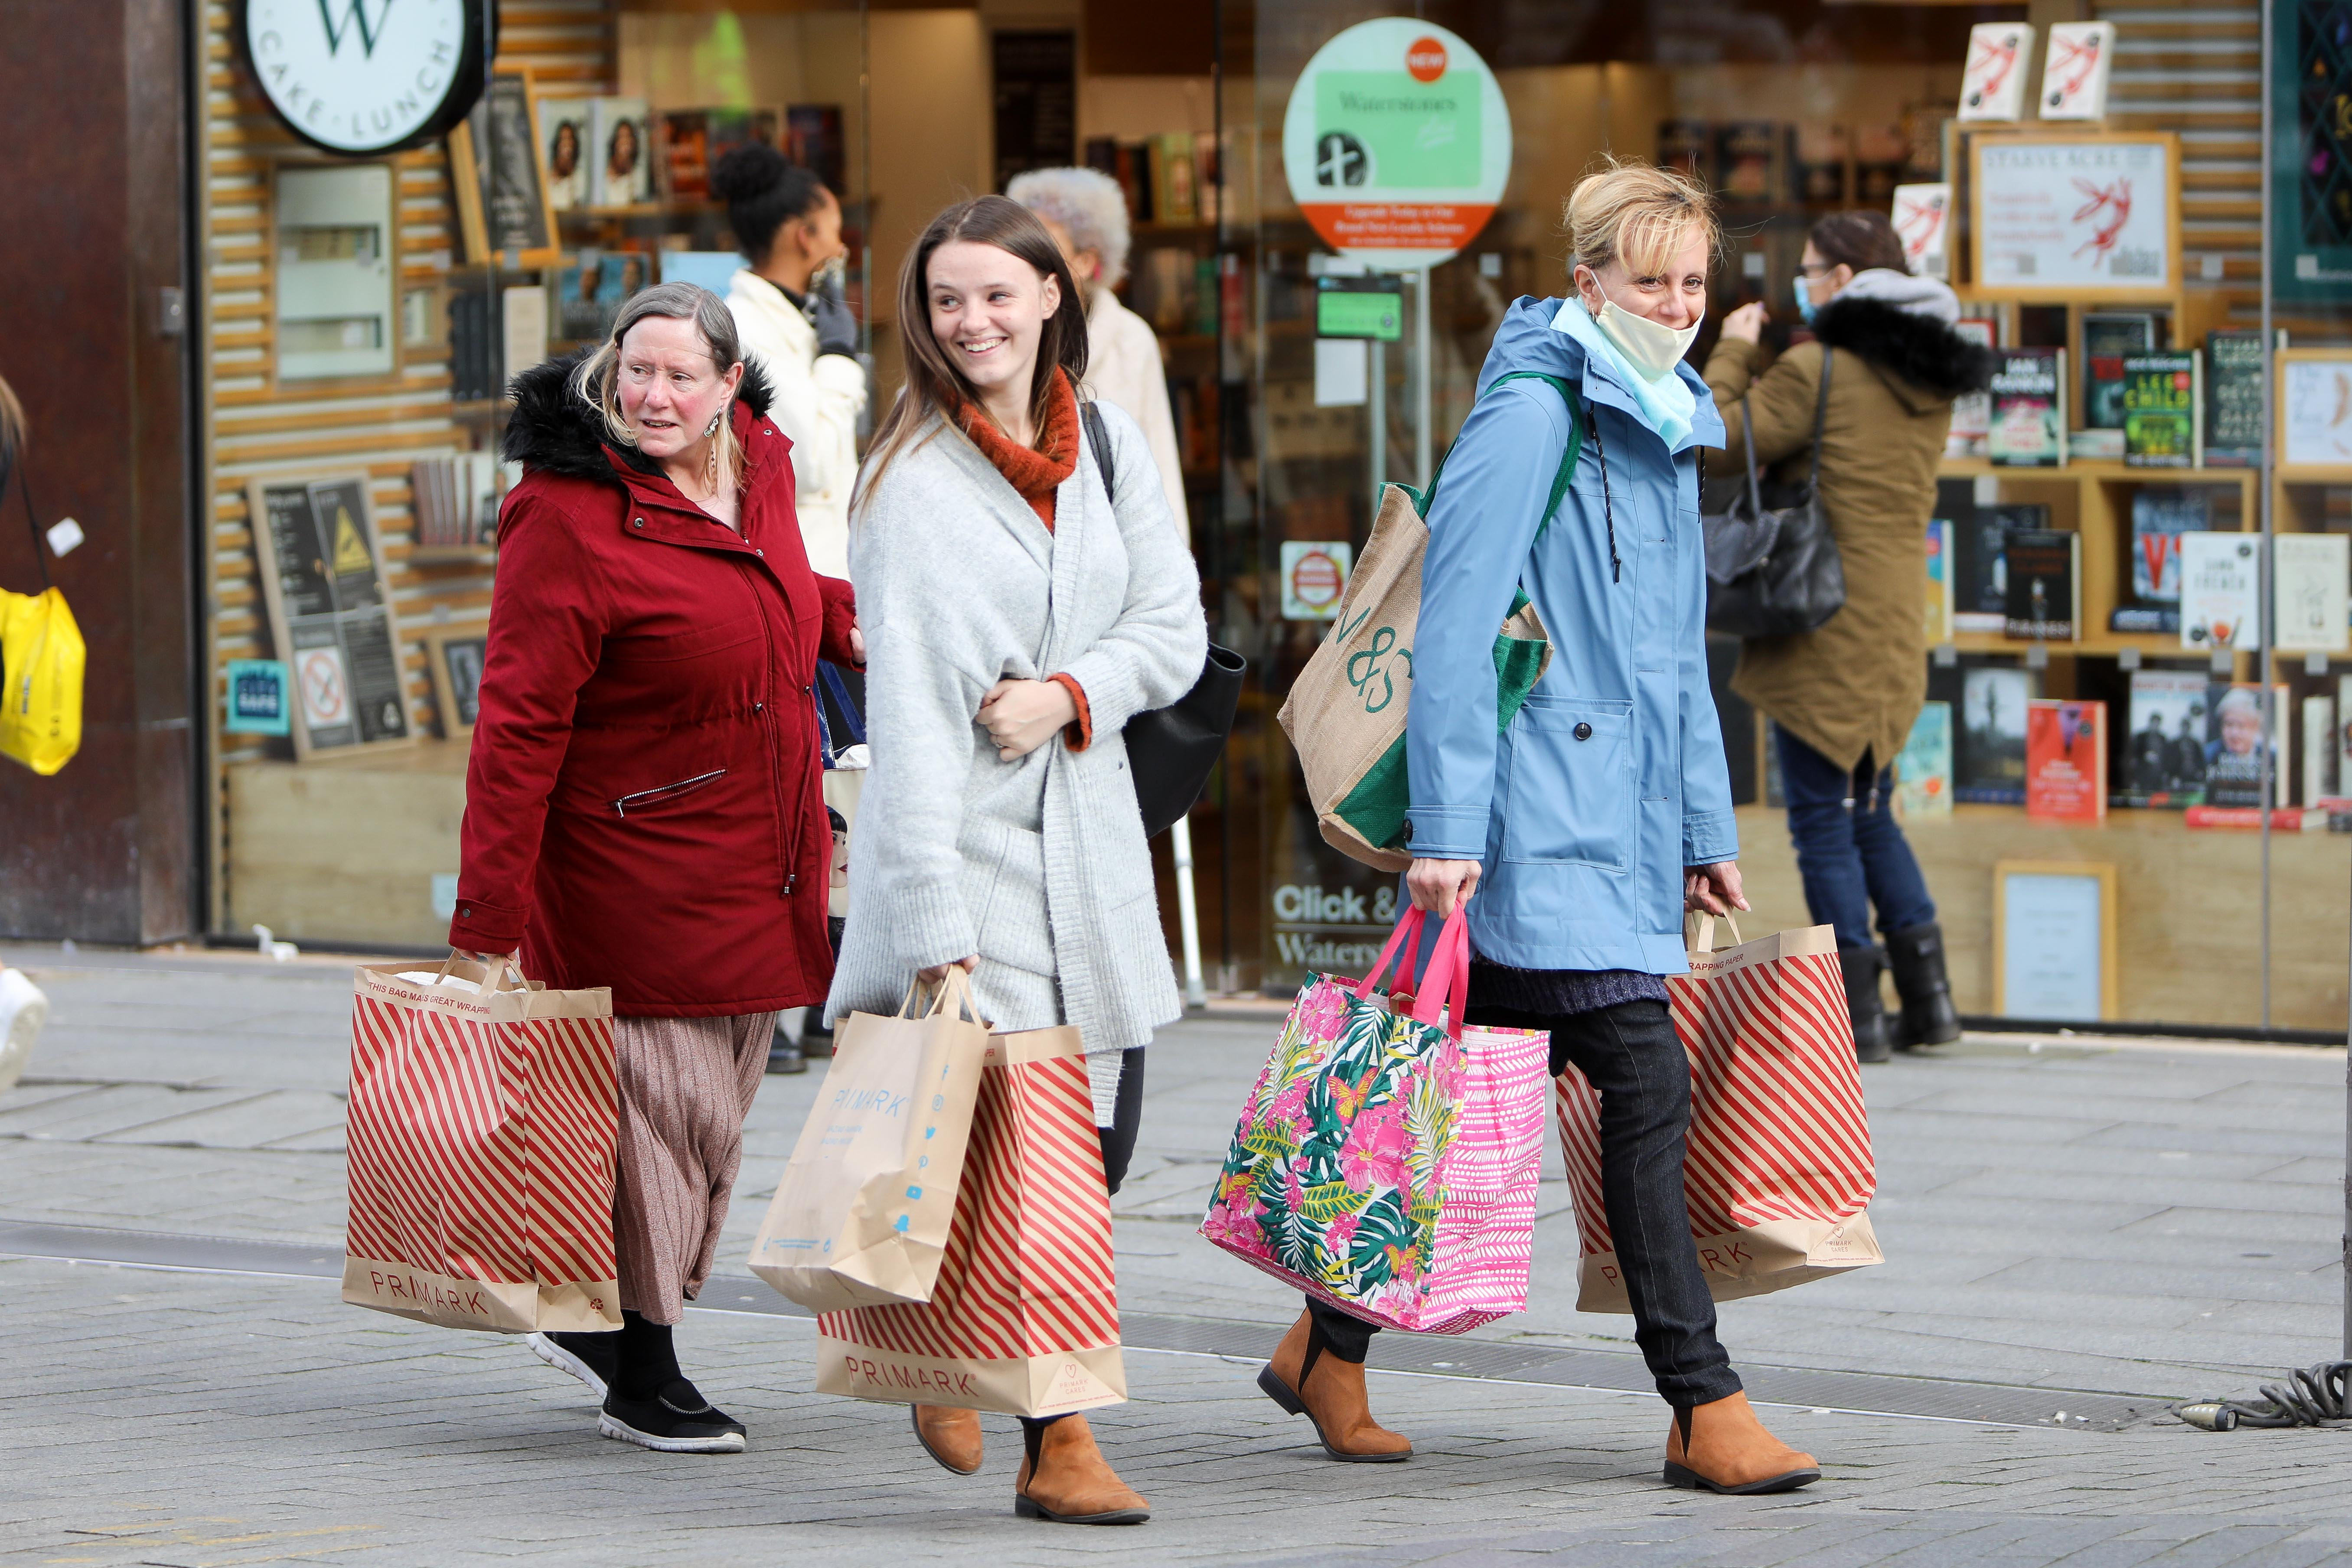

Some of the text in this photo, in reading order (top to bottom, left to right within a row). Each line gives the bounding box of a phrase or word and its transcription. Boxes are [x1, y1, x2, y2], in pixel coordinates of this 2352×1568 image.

[260, 30, 452, 138] CAKE LUNCH
[2212, 338, 2261, 351] STUAR
[2136, 373, 2173, 390] LEE
[2123, 388, 2190, 409] CHILD
[1273, 883, 1396, 924] Click &
[1274, 932, 1387, 966] Waters
[1688, 953, 1744, 971] RAPPING PAPER
[369, 981, 387, 993] THIS
[388, 987, 407, 998] BAG
[430, 995, 456, 1007] GREAT
[457, 1001, 492, 1015] WRAPPIN
[370, 1270, 489, 1315] PRIMARK
[1388, 1274, 1414, 1305] wilko
[846, 1356, 979, 1397] PRIMARK
[1059, 1379, 1088, 1388] PRIMARK
